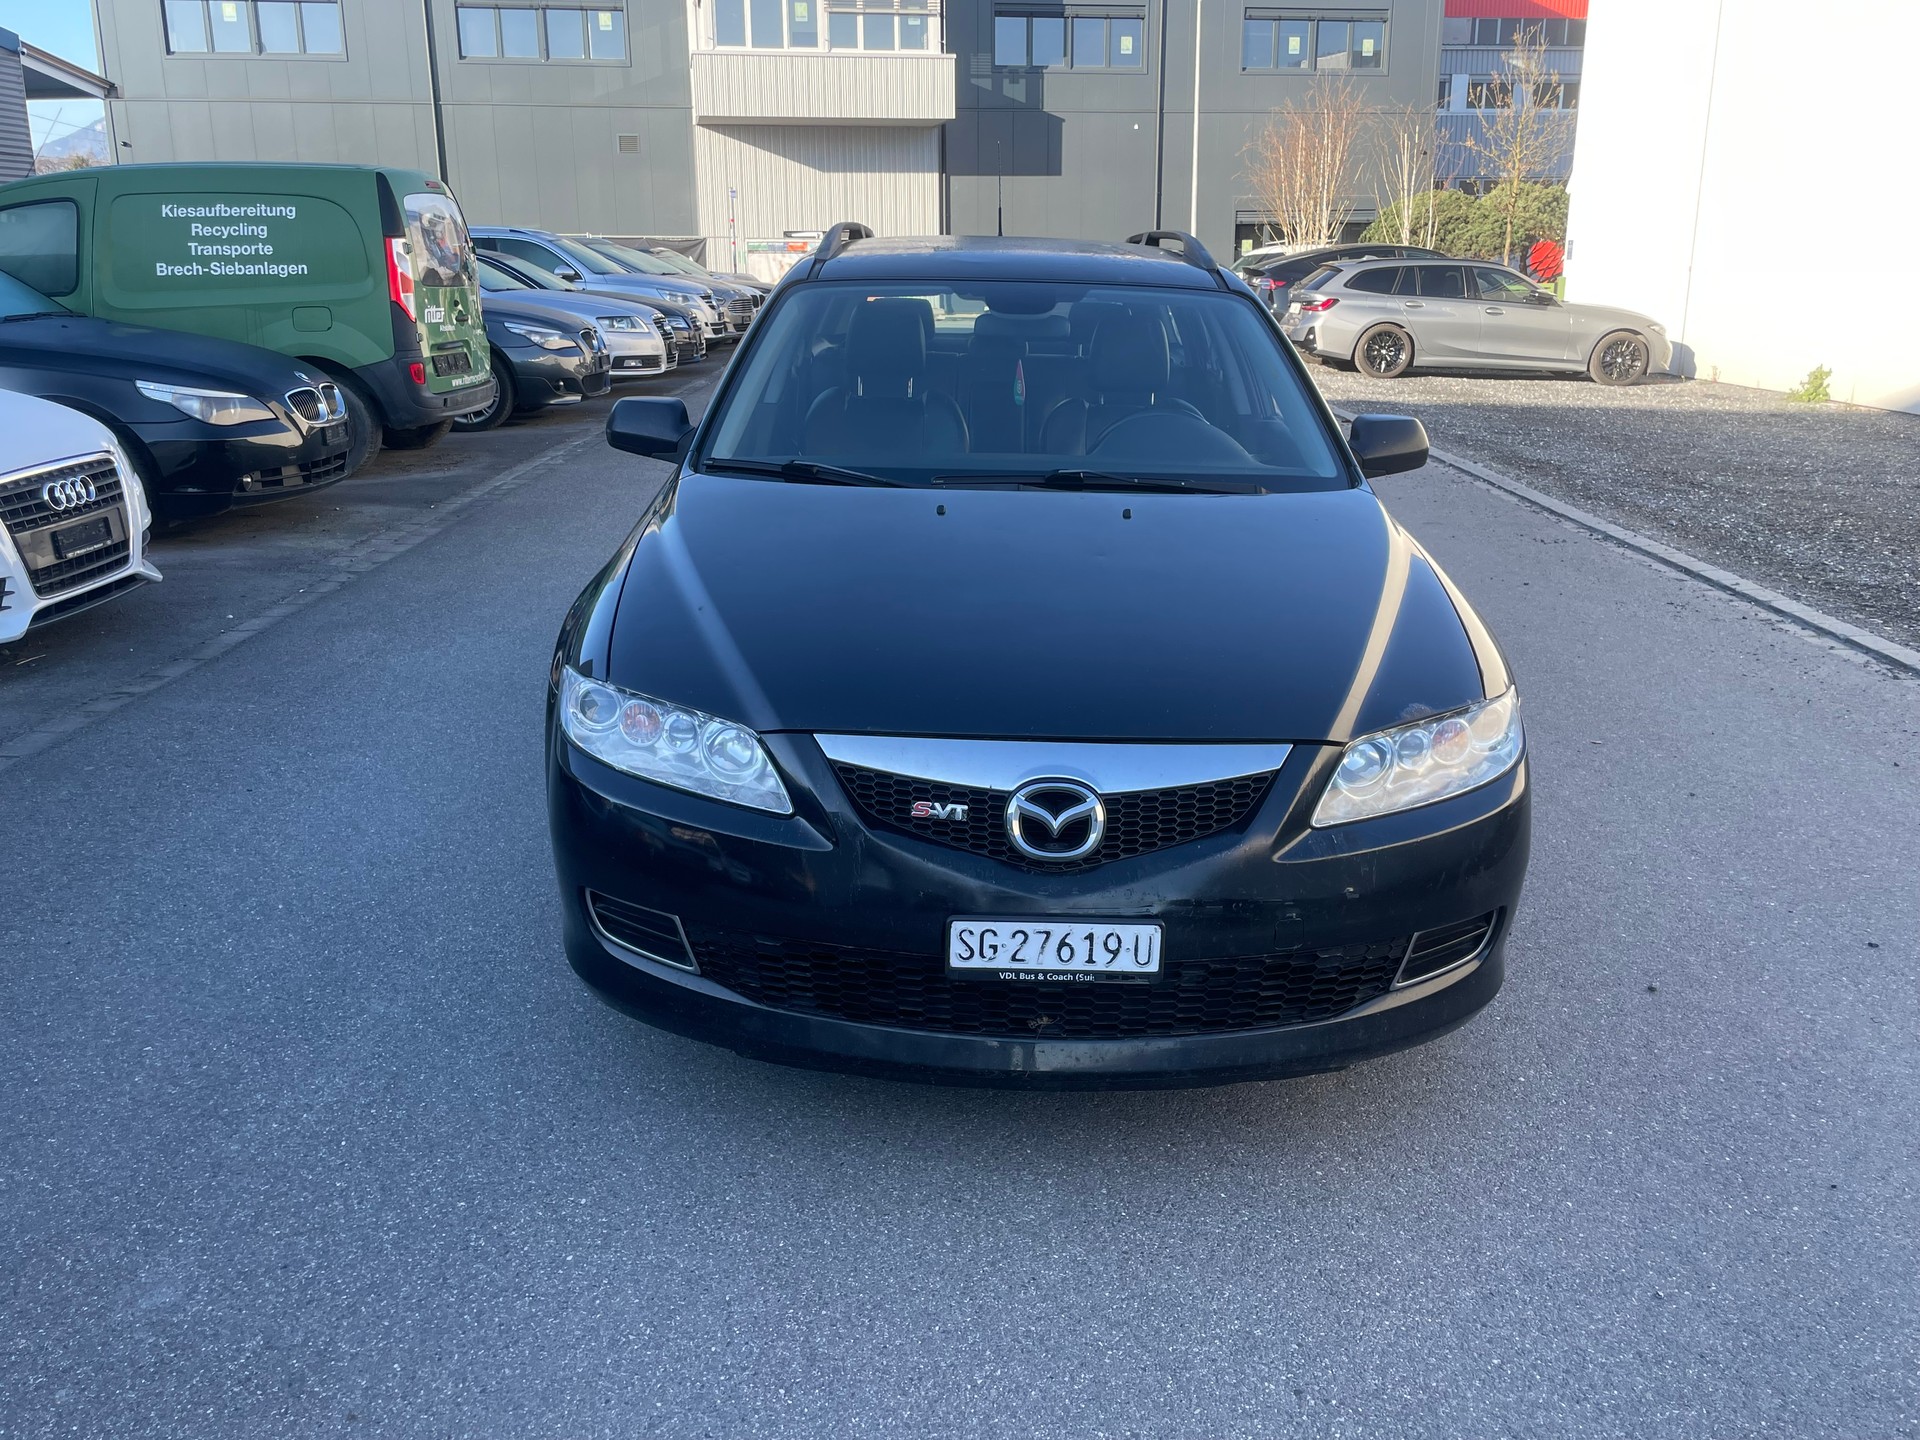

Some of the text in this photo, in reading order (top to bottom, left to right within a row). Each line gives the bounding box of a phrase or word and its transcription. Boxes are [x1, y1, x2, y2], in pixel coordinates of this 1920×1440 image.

[161, 203, 296, 220] Kiesaufbereitung
[191, 222, 268, 239] Recycling
[187, 242, 274, 258] Transporte
[156, 261, 308, 278] Brech-Siebanlagen
[998, 972, 1017, 980] VDL
[1020, 972, 1035, 980] Bus
[1037, 972, 1045, 980] &
[1047, 972, 1074, 981] Coach
